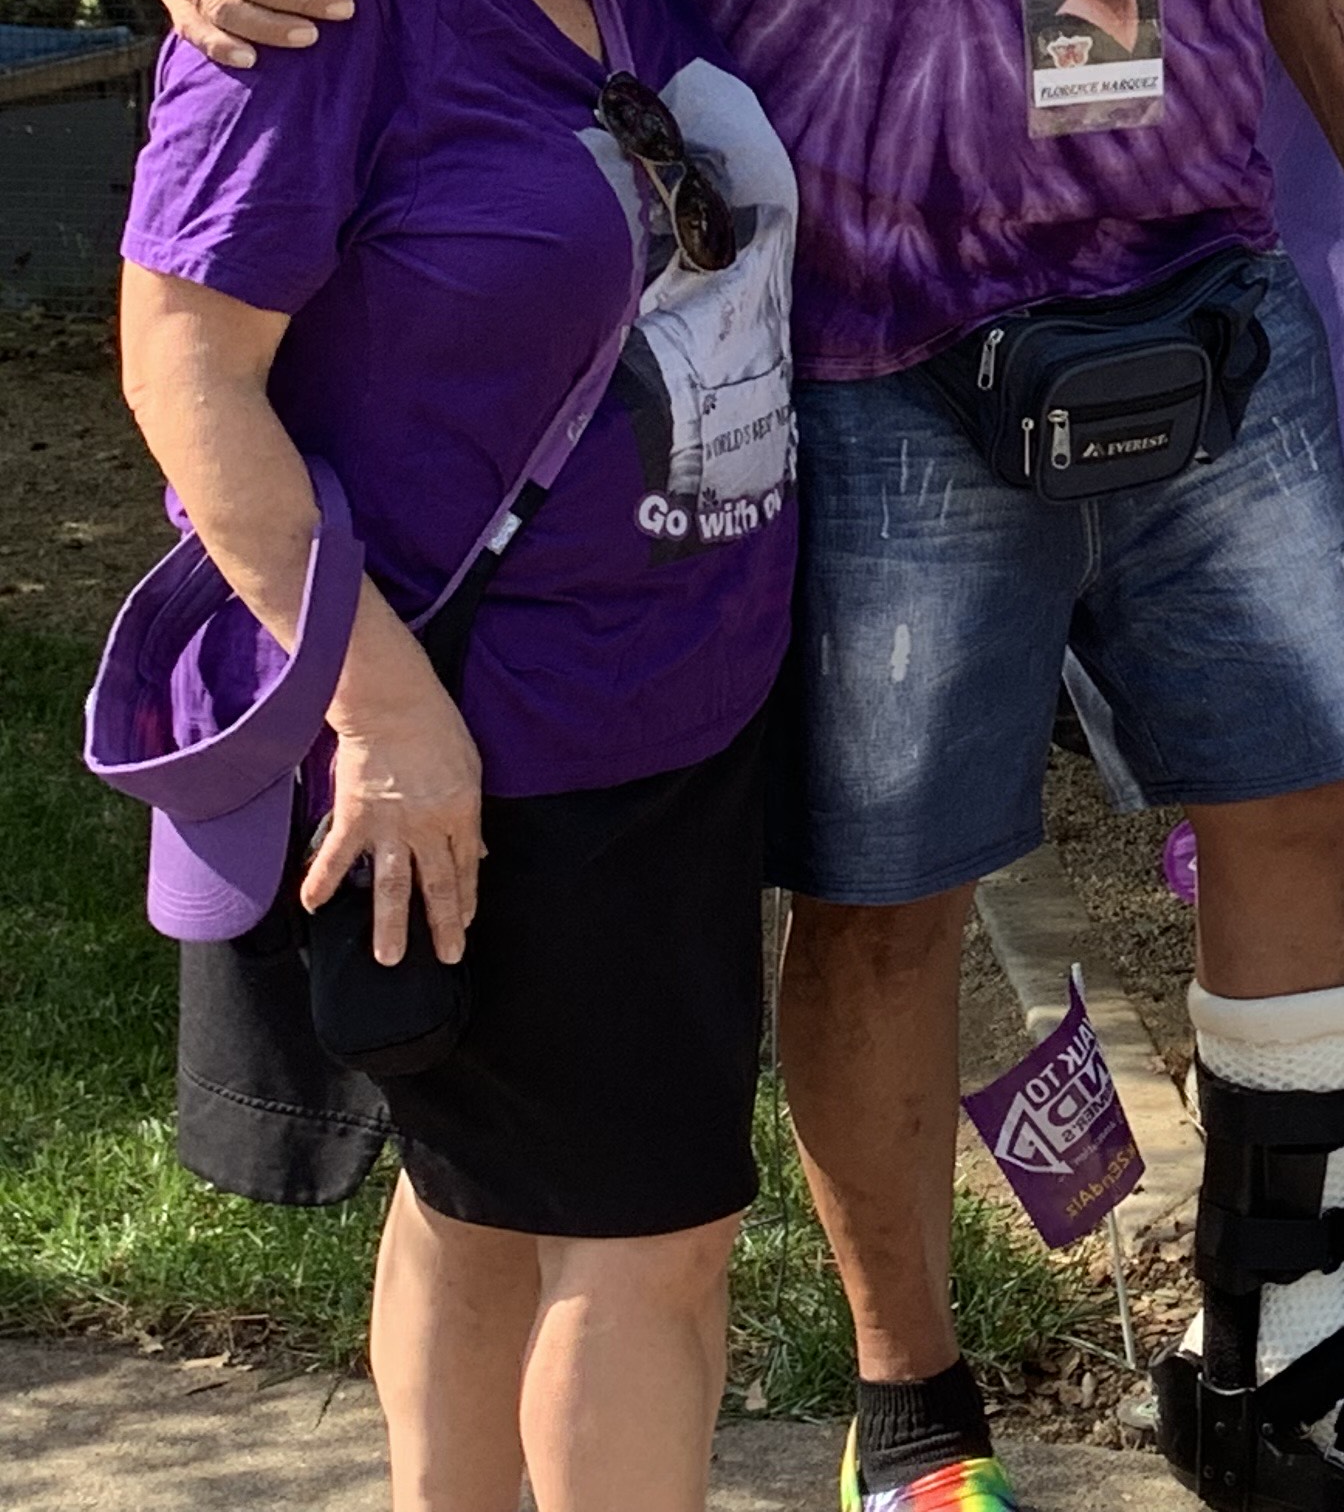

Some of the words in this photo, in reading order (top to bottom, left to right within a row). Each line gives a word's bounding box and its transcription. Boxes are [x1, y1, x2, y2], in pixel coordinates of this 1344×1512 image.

[1101, 76, 1159, 92] MARQUEZ
[1108, 433, 1167, 456] EVEREST
[638, 494, 688, 537] Go
[699, 499, 759, 539] with
